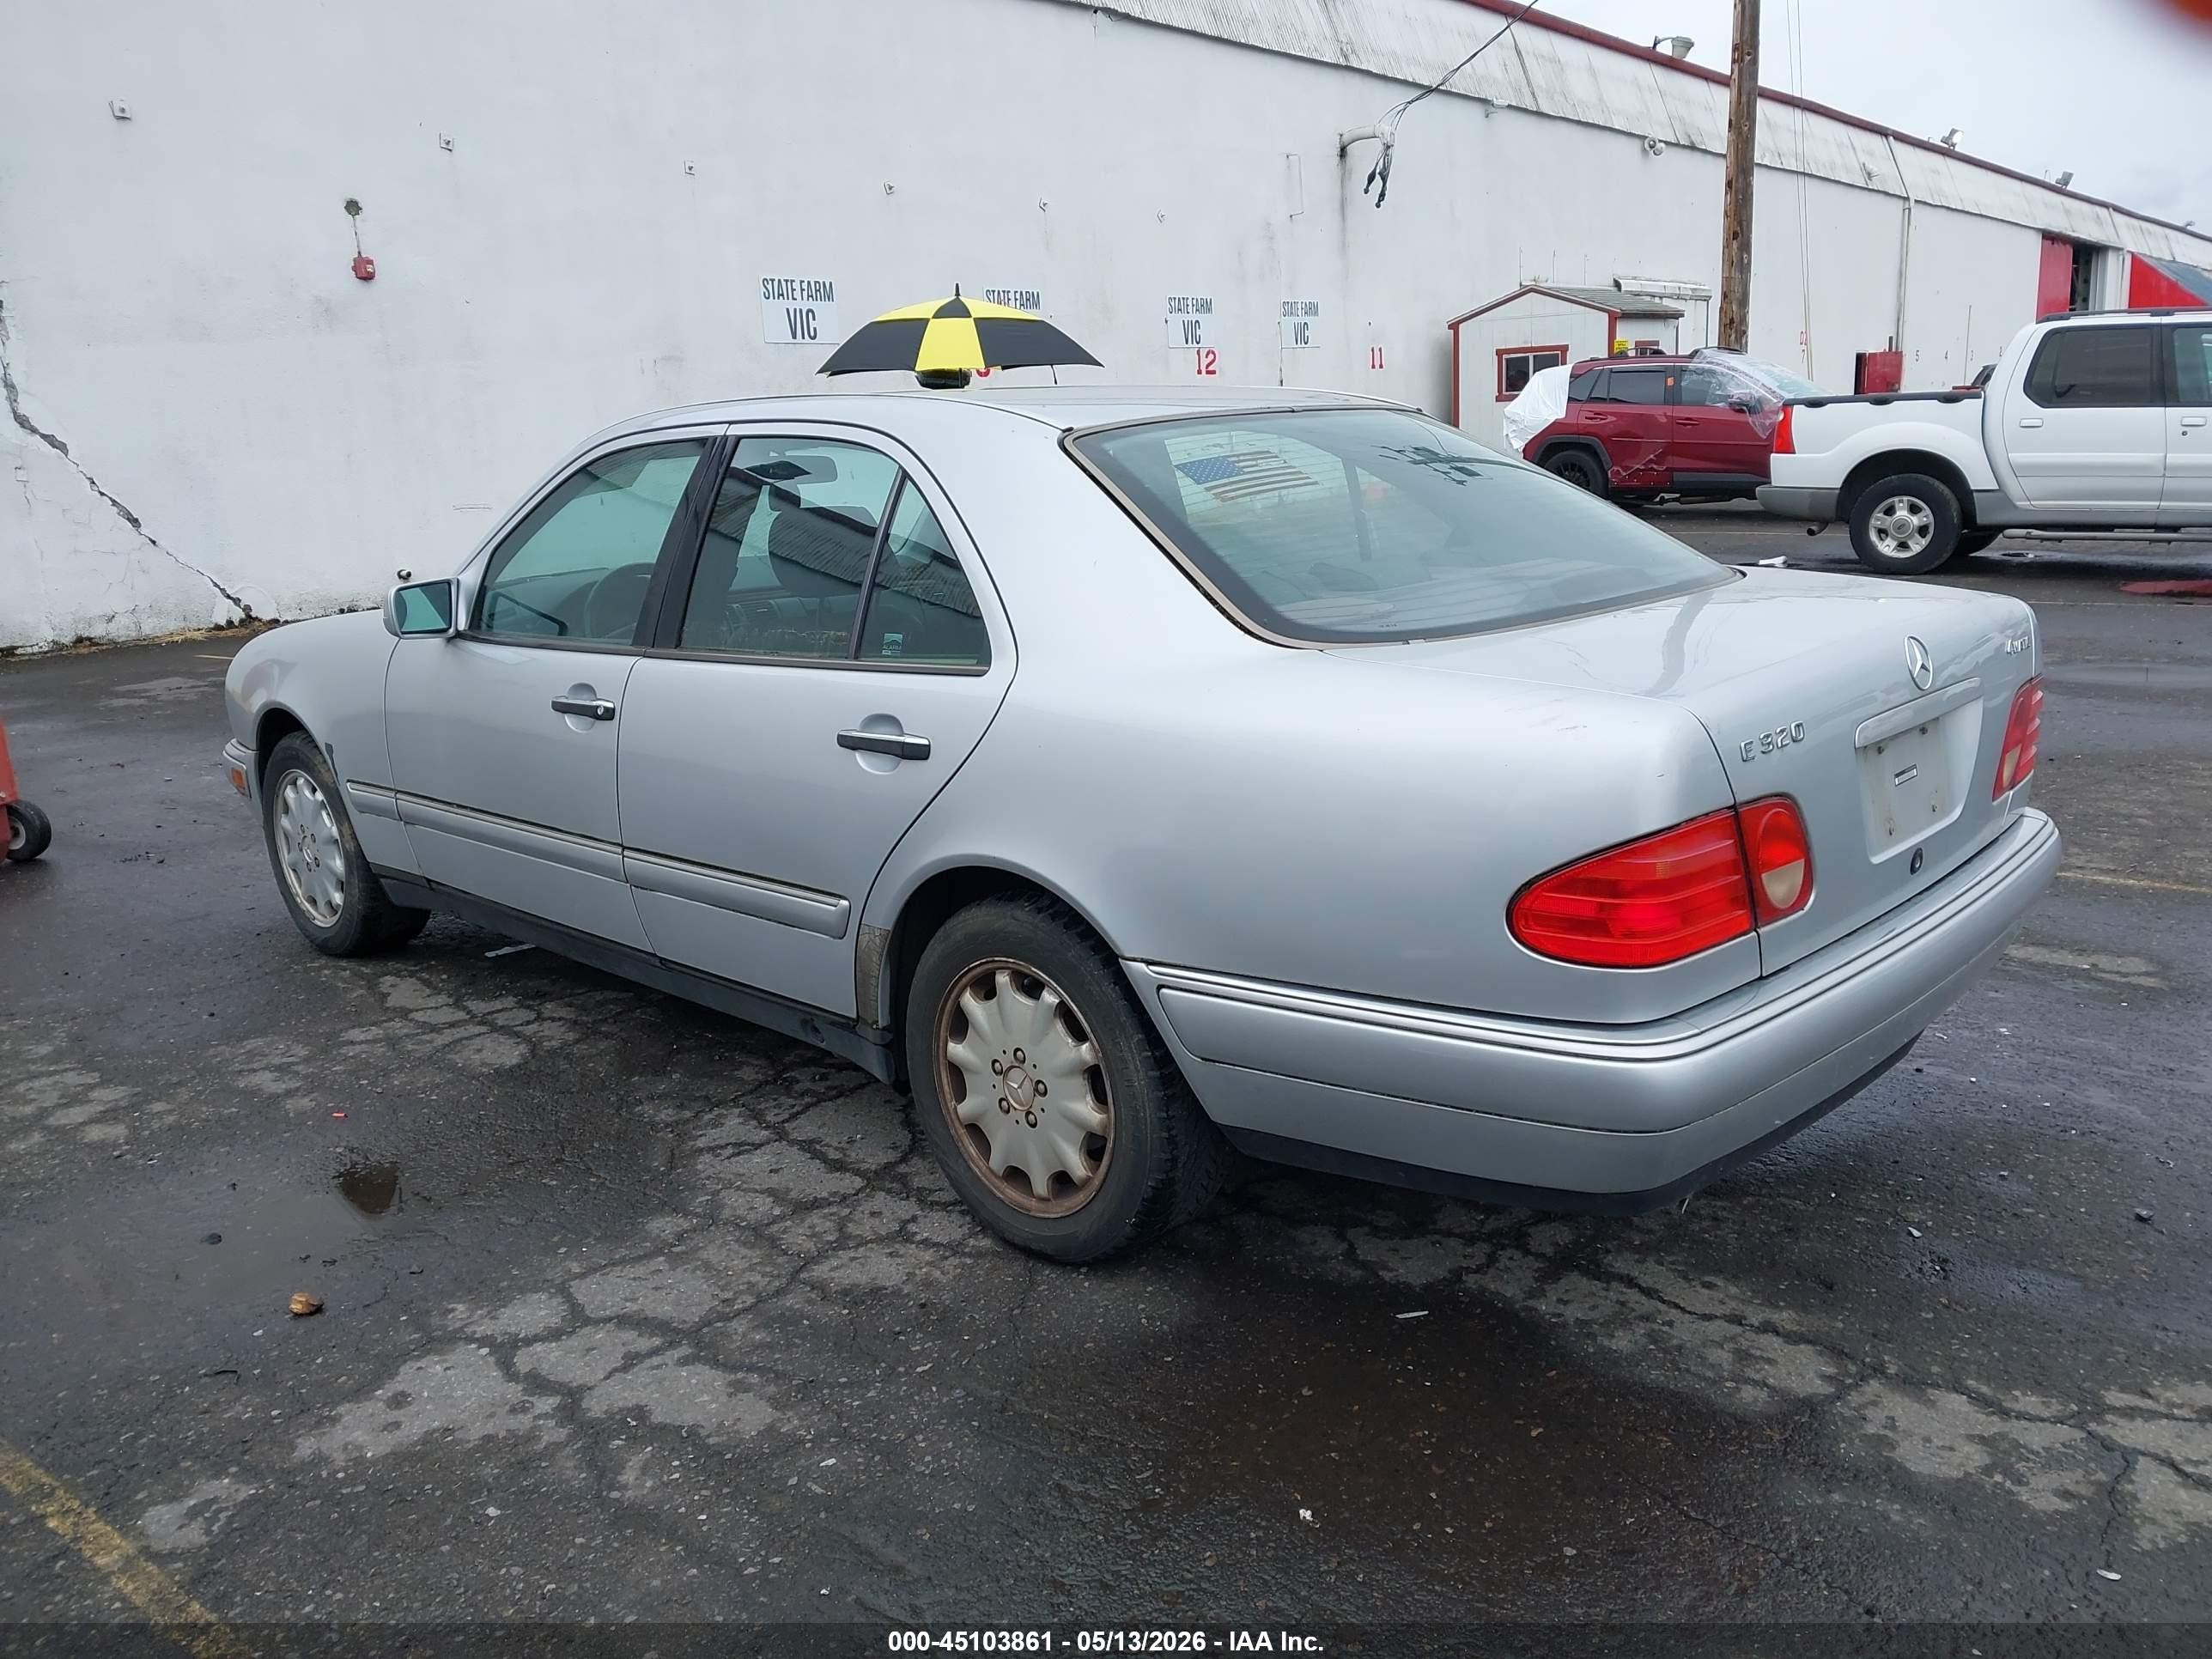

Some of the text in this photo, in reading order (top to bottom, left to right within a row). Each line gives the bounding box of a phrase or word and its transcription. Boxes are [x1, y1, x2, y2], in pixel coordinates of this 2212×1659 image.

[762, 276, 835, 302] STATE FARM
[1013, 290, 1041, 310] FARM
[1168, 296, 1213, 315] STATE FARM
[1282, 301, 1319, 318] STATE FARM
[785, 307, 817, 341] VIC
[1182, 319, 1201, 345] VIC
[1293, 321, 1310, 345] VIC
[1196, 348, 1217, 375] 12
[1370, 346, 1383, 369] 11
[1916, 349, 1920, 362] 5
[1740, 720, 1805, 763] E 320
